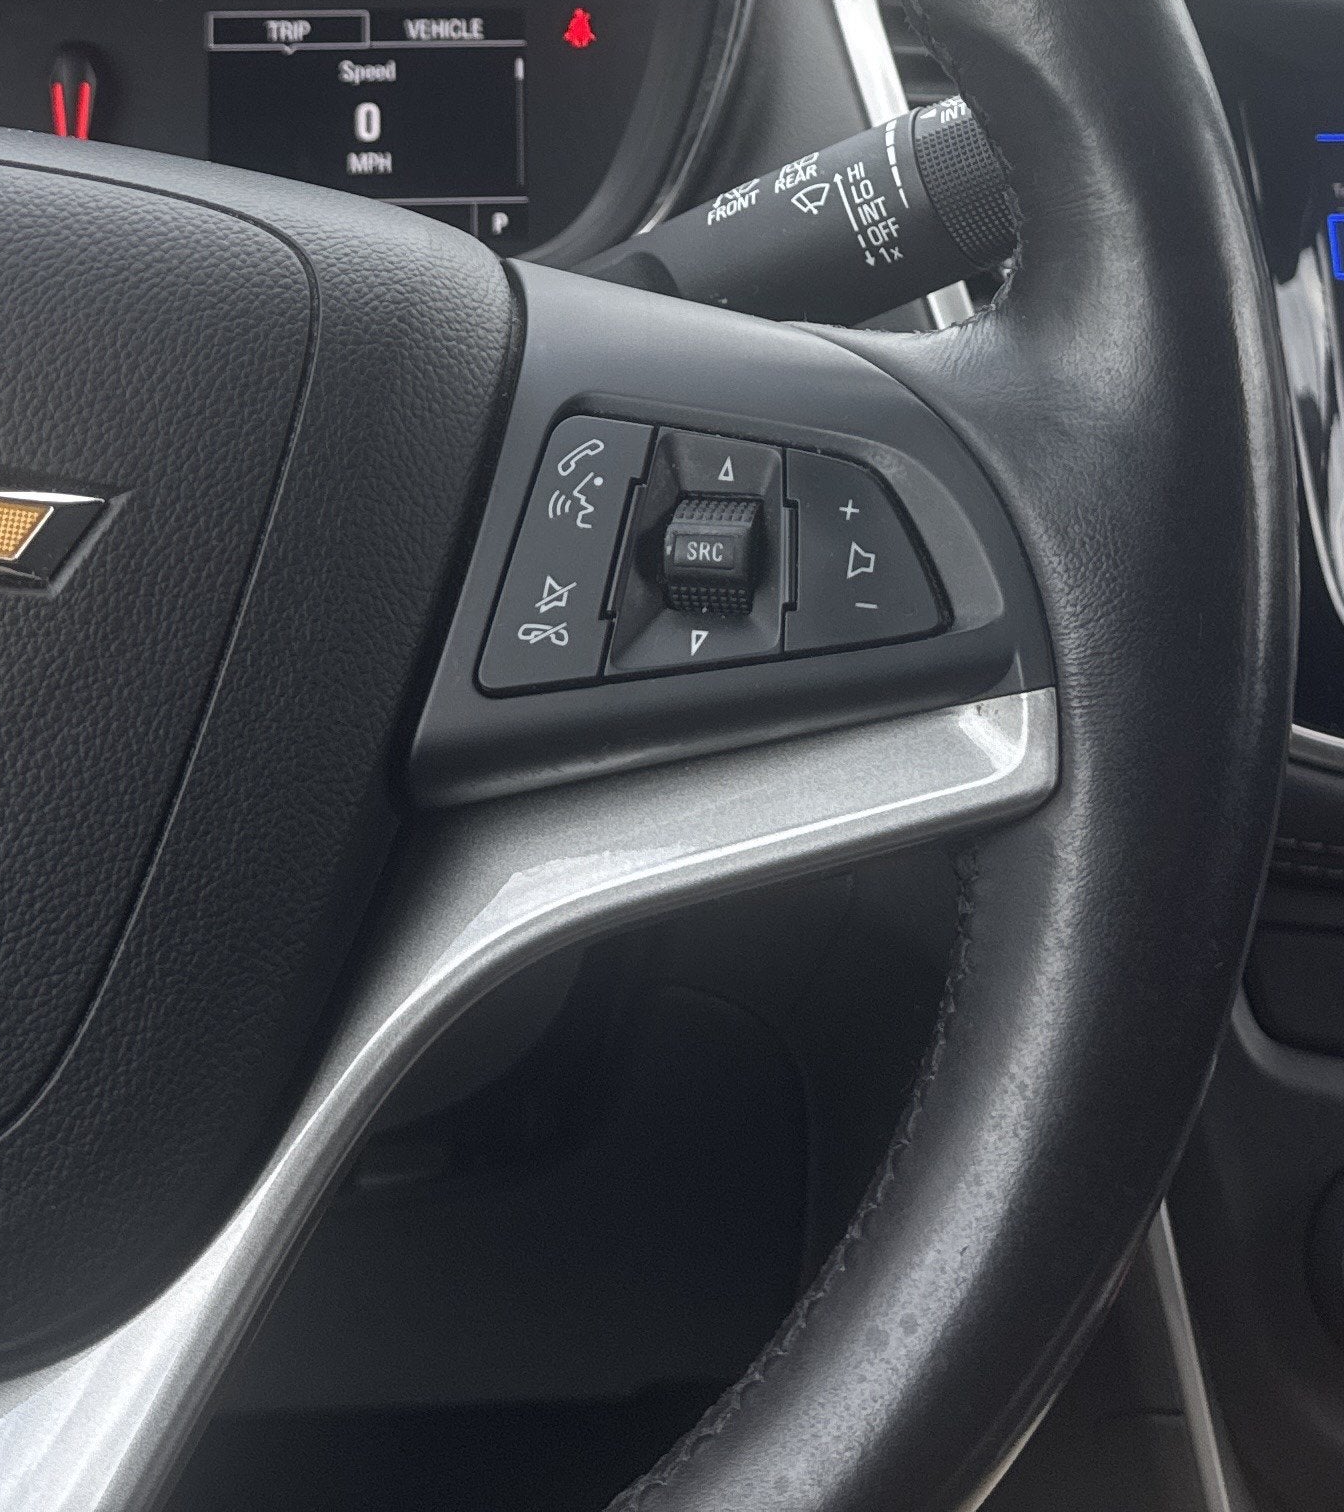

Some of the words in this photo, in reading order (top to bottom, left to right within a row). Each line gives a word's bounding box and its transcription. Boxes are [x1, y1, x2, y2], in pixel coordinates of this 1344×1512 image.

[265, 19, 312, 43] TRIP
[404, 17, 485, 40] VEHICLE
[337, 59, 397, 85] Speed
[355, 101, 382, 143] 0
[346, 152, 393, 175] MPH
[846, 161, 866, 184] HI
[774, 164, 818, 194] REAR
[850, 179, 874, 205] LO
[706, 189, 760, 226] FRONT
[856, 196, 888, 226] INT
[492, 211, 510, 235] P
[866, 217, 900, 246] OFF
[878, 246, 904, 264] 1x
[686, 541, 724, 562] SRC
